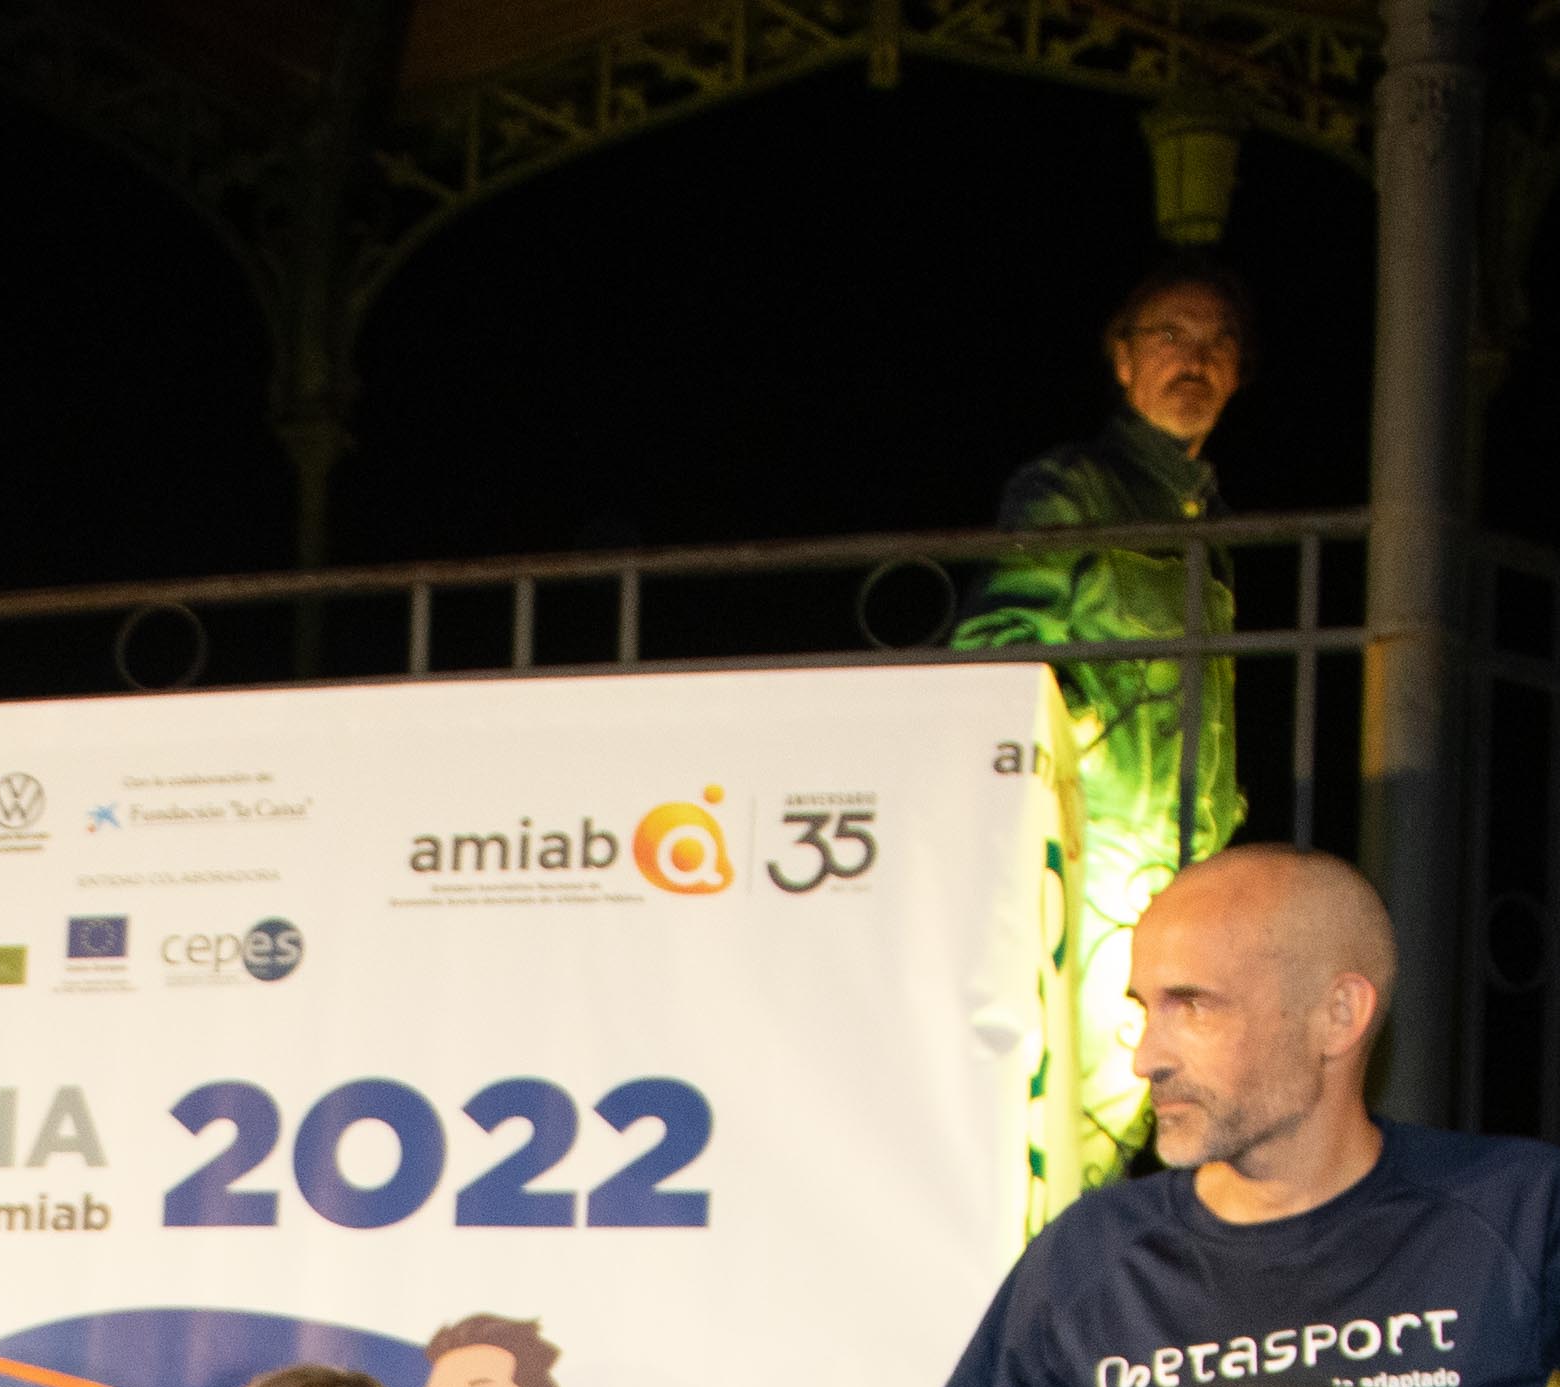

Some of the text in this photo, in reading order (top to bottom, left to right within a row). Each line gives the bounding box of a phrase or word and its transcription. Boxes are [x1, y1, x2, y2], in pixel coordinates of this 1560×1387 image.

[410, 815, 620, 873] amiab
[766, 810, 878, 893] 35
[160, 929, 302, 971] cepes
[163, 1076, 714, 1229] 2022
